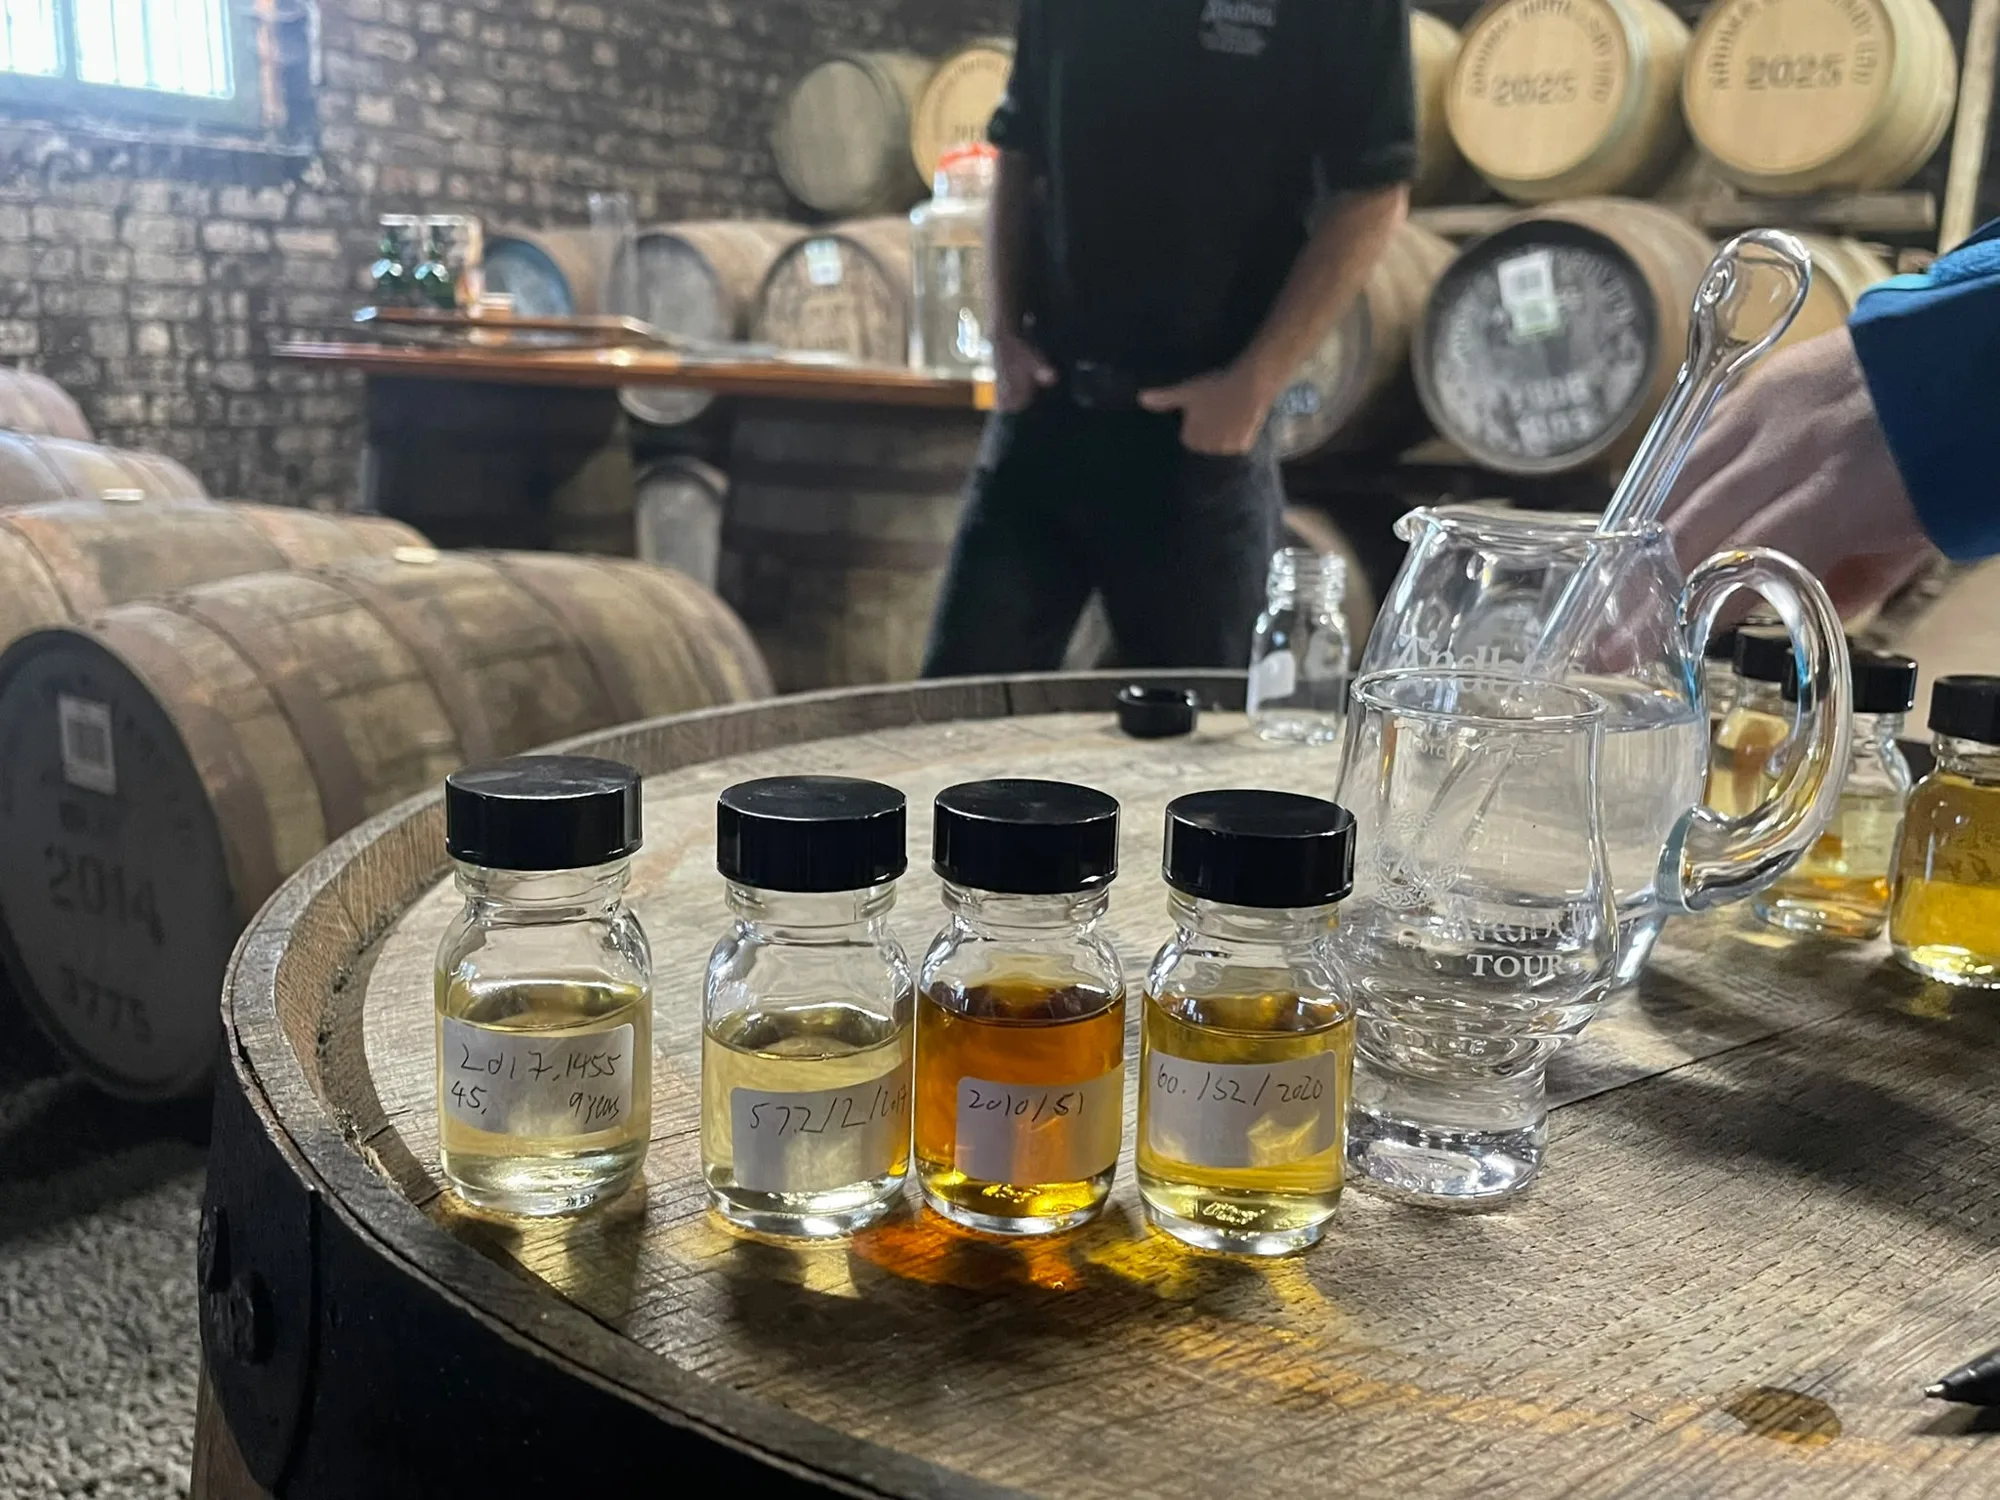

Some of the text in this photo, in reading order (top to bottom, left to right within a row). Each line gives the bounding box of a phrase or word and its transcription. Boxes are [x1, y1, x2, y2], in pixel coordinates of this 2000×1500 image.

[1745, 52, 1844, 90] 2025
[44, 842, 165, 947] 2014
[1467, 954, 1566, 977] TOUR
